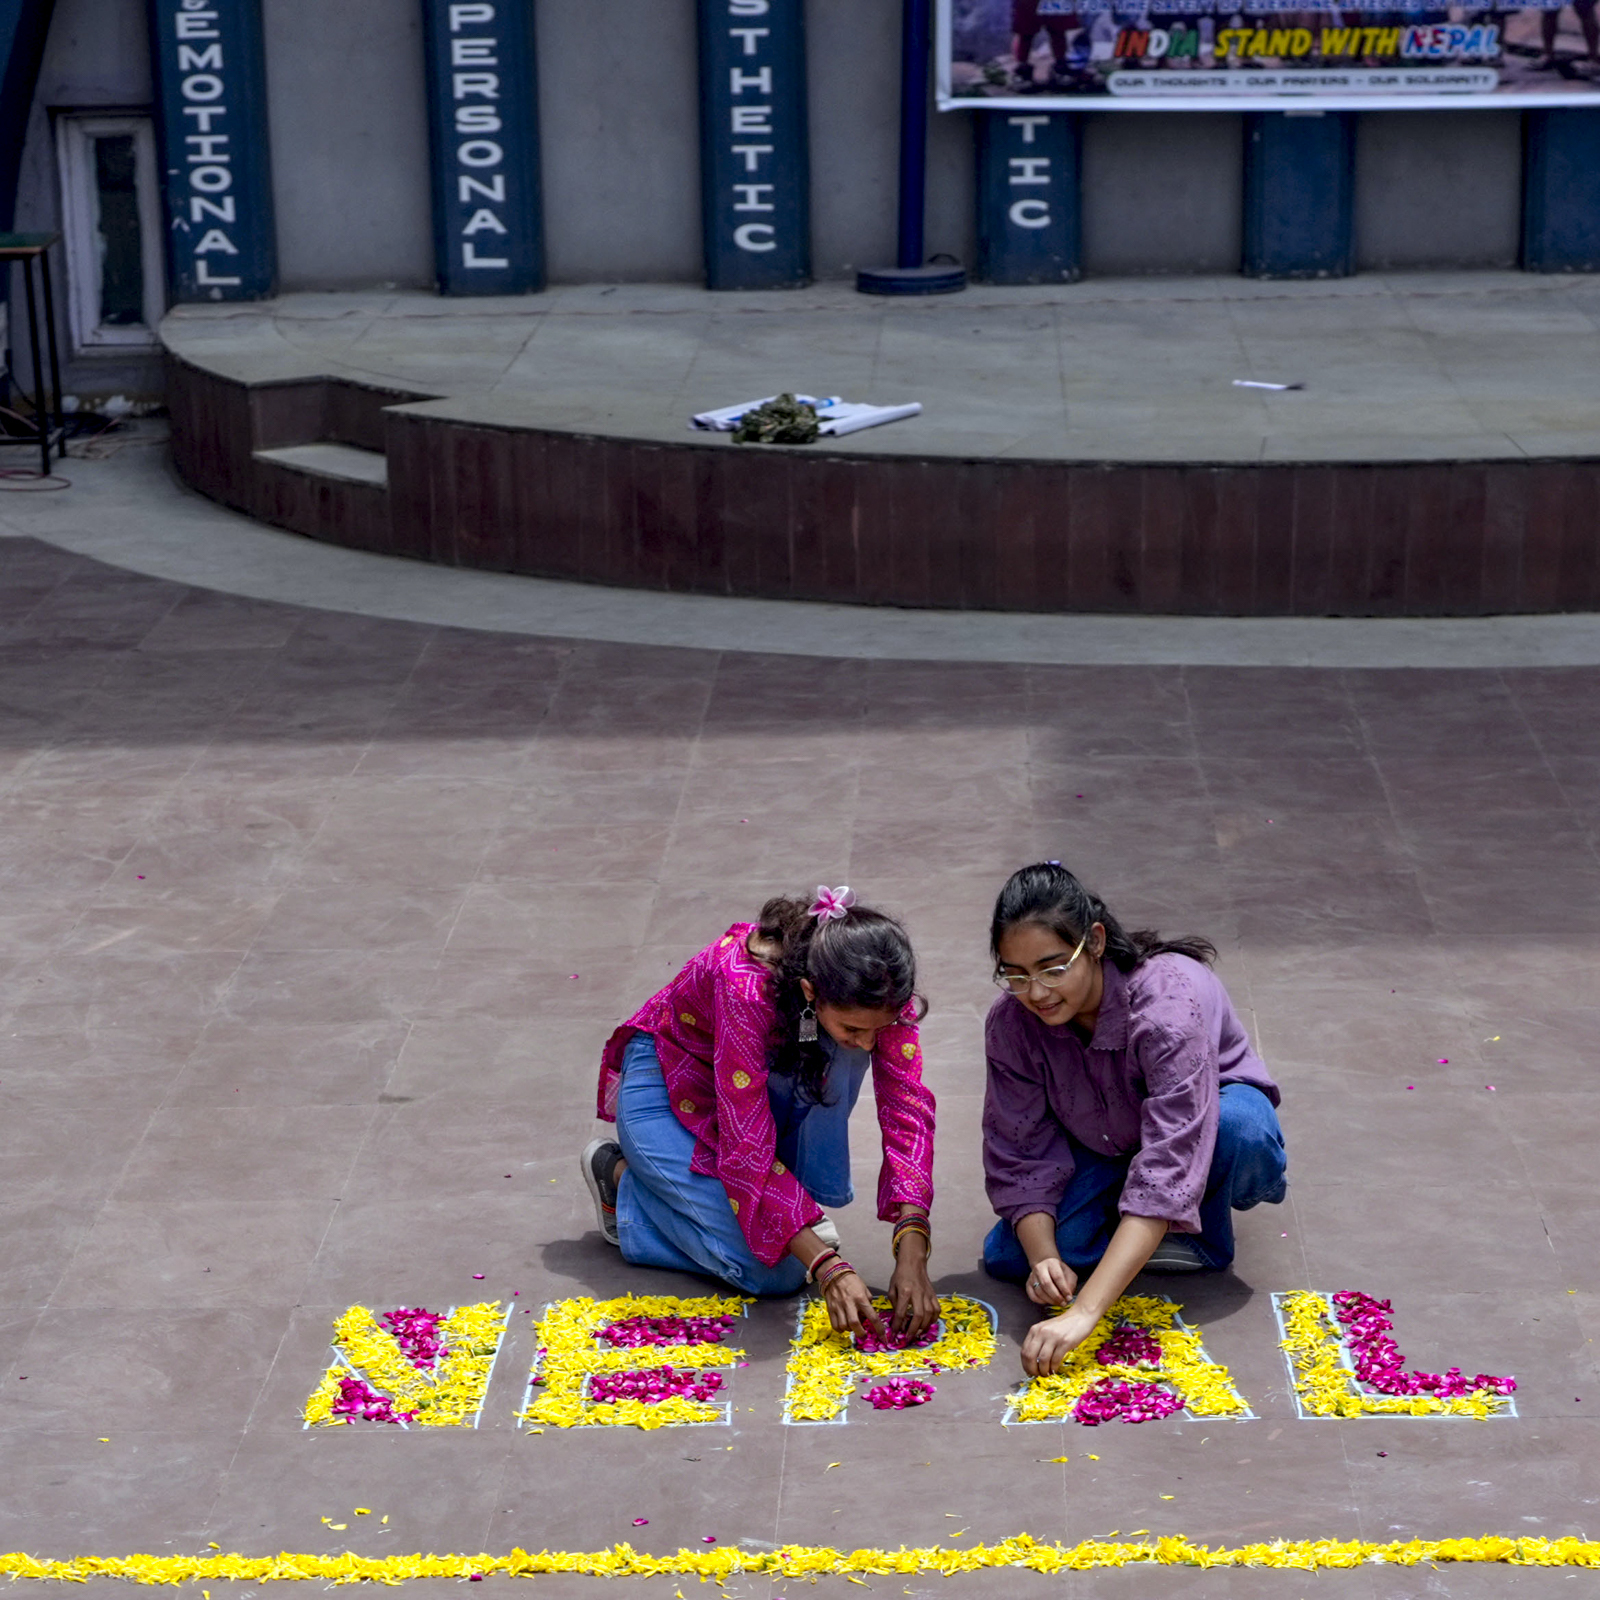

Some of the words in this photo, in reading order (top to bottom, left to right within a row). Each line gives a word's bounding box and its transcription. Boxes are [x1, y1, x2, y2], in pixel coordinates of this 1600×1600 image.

[1114, 30, 1199, 57] INDIA
[1214, 28, 1312, 57] STAND
[1321, 27, 1400, 56] WITH
[1402, 24, 1499, 57] NEPAL
[1114, 77, 1145, 86] OUR
[1153, 77, 1227, 86] THOUGHTS
[1246, 76, 1277, 86] OUR
[1281, 76, 1349, 86] PRAYERS
[1368, 76, 1399, 85] OUR
[1405, 75, 1490, 85] SOLIDARITY
[177, 11, 240, 286] EMOTIONAL
[450, 3, 508, 268] PERSONAL
[302, 1288, 1520, 1430] NEPAL
